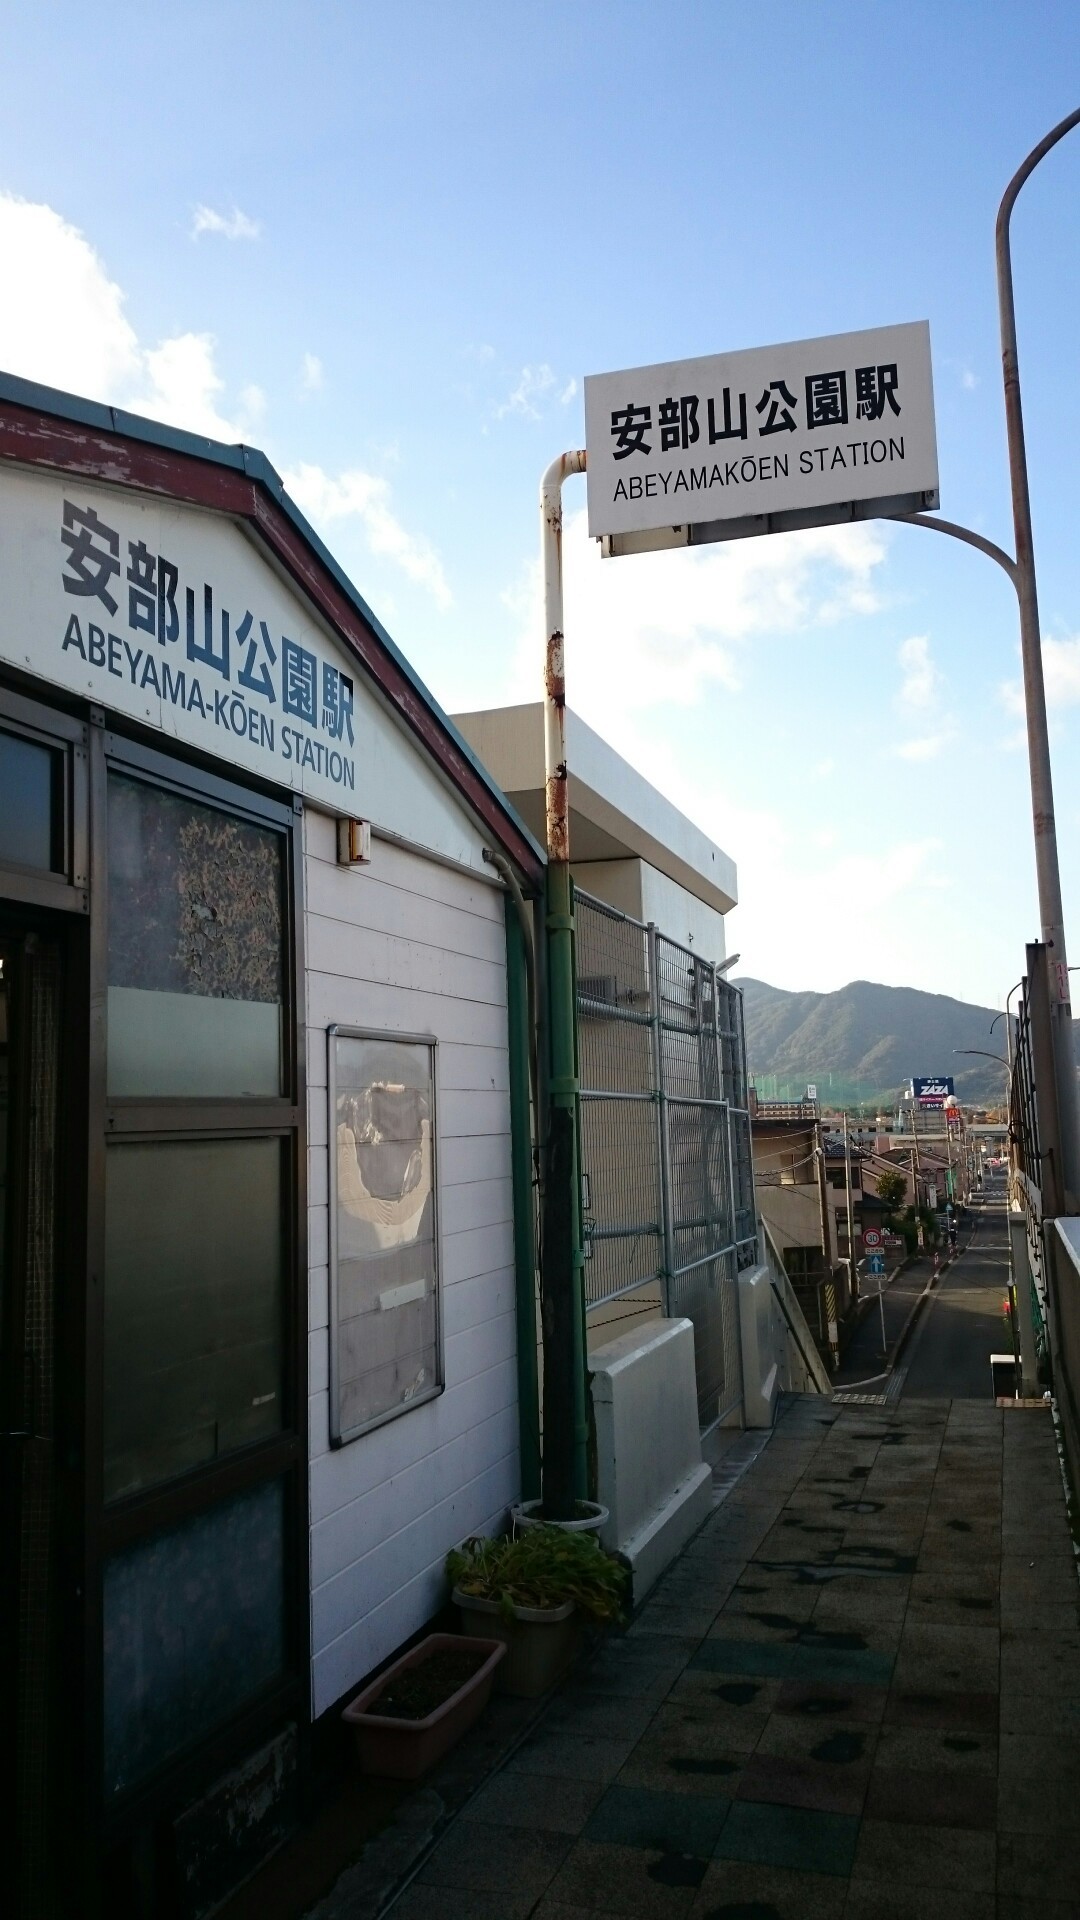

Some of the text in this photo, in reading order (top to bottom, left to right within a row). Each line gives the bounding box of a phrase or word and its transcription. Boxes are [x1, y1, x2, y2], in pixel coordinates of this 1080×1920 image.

[610, 363, 901, 460] 安部山公園駅
[613, 436, 906, 502] ABEYAMAKŌEN STATION
[60, 498, 355, 748] 安部山公園駅
[61, 613, 355, 791] ABEYAMA-KŌEN STATION
[920, 1084, 949, 1095] ZAZA
[867, 1234, 878, 1243] 30
